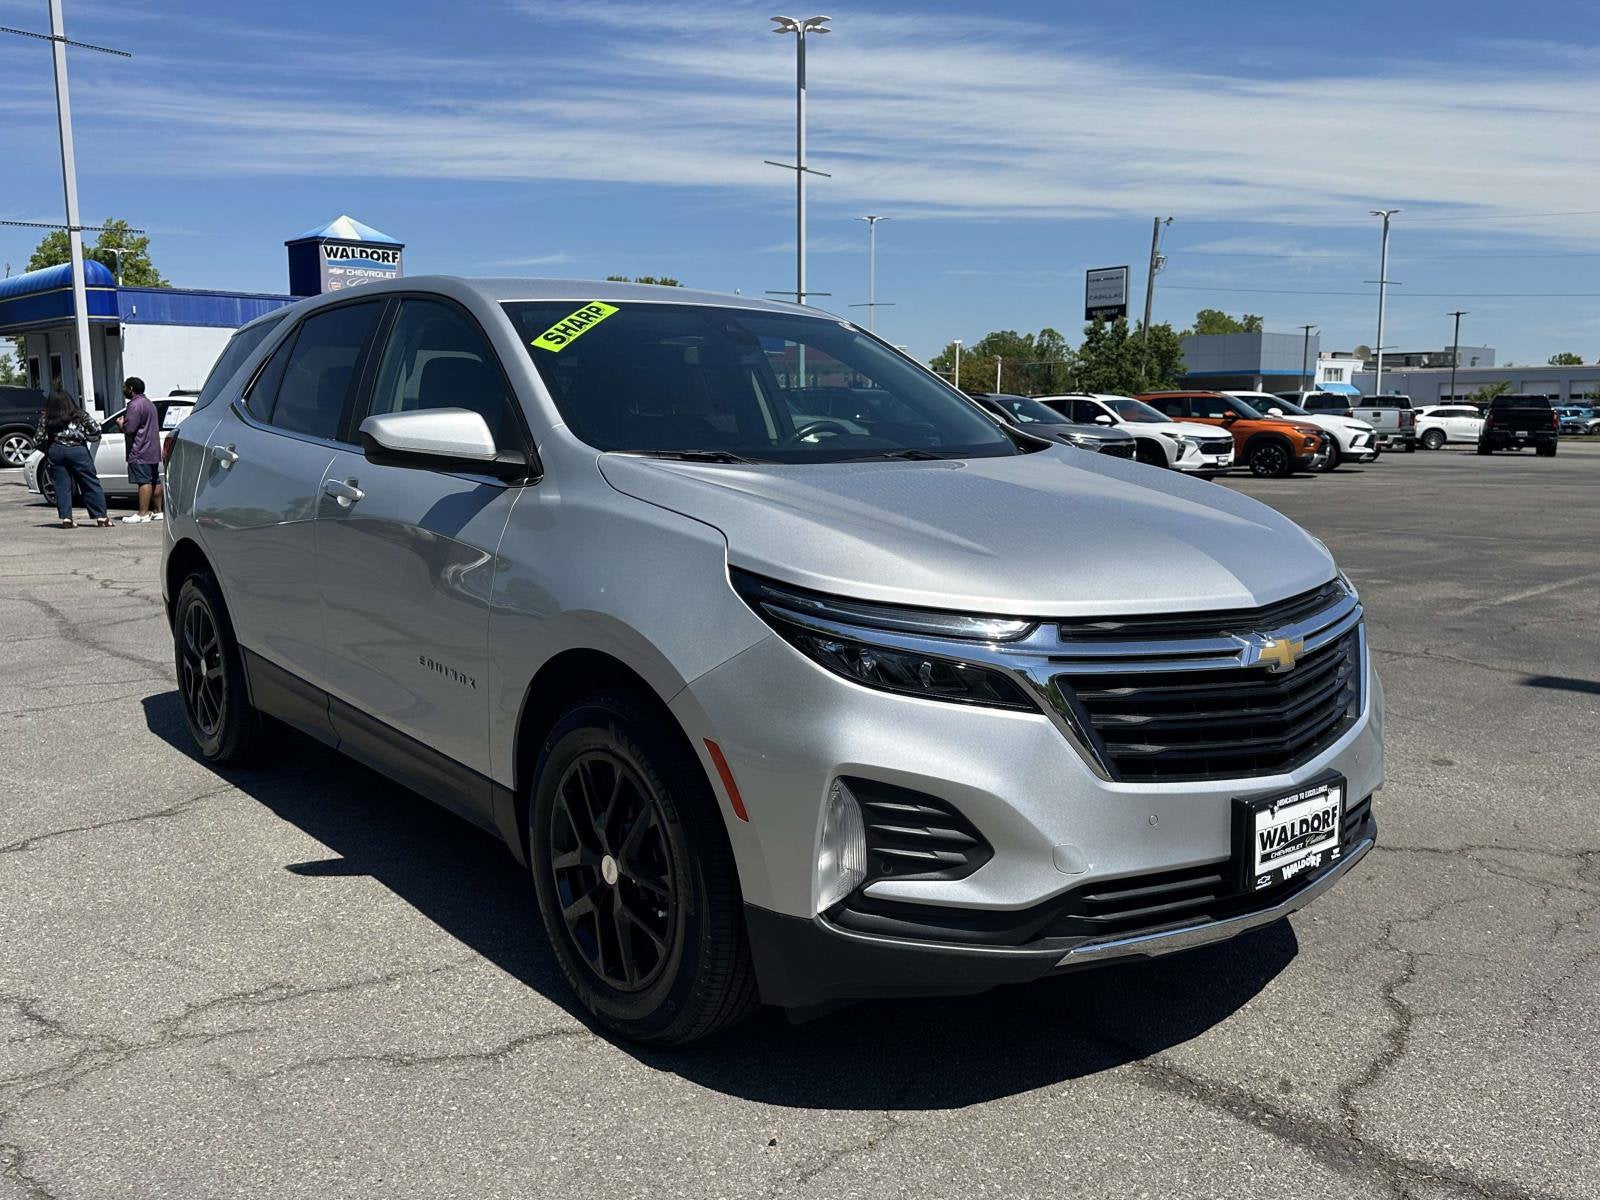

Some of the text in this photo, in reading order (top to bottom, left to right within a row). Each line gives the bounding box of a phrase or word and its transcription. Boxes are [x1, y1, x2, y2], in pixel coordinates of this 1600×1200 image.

[323, 245, 399, 263] WALDORF
[346, 268, 396, 279] CHEVROLET
[543, 305, 603, 345] SHARP
[1276, 785, 1328, 807] DEDICATED TO EXCELLENCE
[1259, 805, 1338, 851] WALDORF
[1270, 843, 1303, 859] CHEVROLET
[1281, 853, 1322, 880] WALDORF
